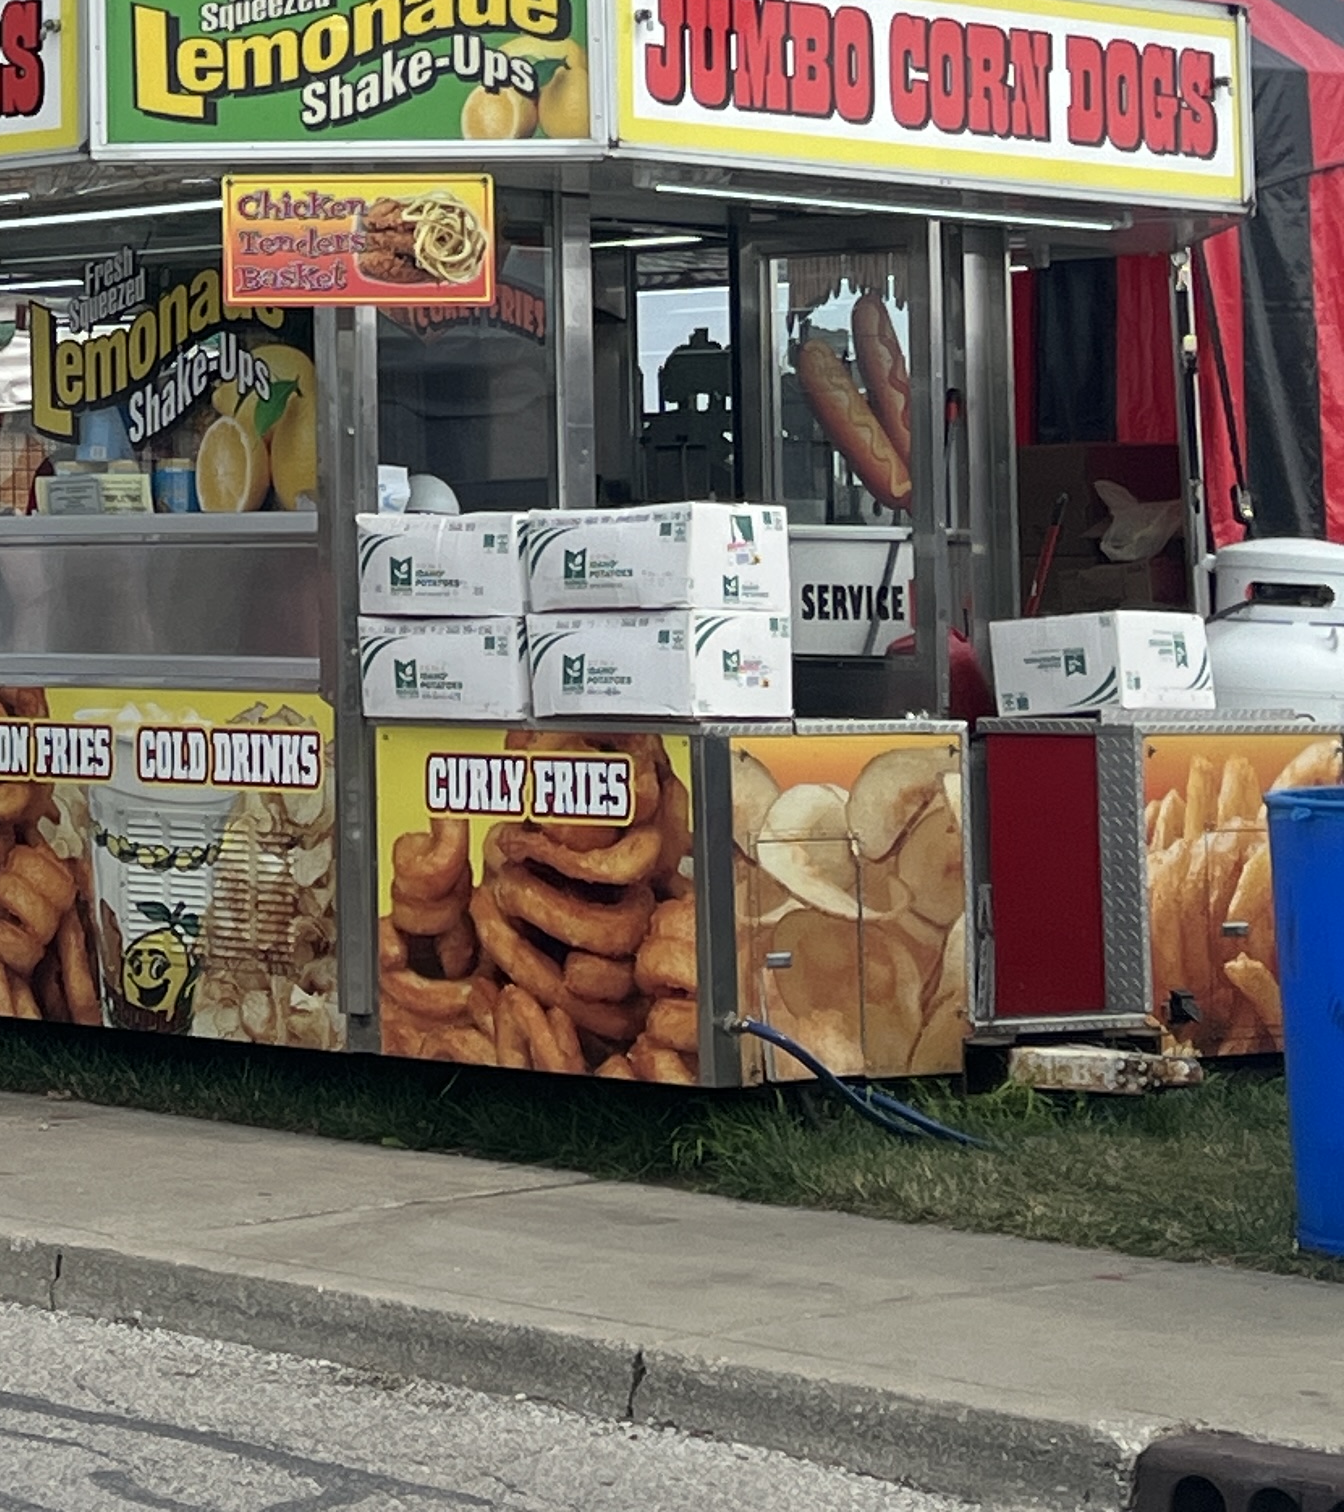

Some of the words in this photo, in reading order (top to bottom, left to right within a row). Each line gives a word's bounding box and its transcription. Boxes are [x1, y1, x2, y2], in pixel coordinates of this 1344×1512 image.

[300, 35, 534, 126] Shake-Ups
[889, 12, 1052, 142] CORN
[1065, 34, 1215, 160] DOGS
[236, 189, 369, 221] Chicken
[239, 228, 367, 258] Tenders
[84, 246, 133, 297] Fresh
[236, 259, 348, 294] Basket
[68, 268, 146, 333] Squeezed
[129, 332, 271, 443] Shake-Ups
[801, 584, 904, 621] SERVICE
[34, 728, 111, 776] FRIES
[139, 731, 207, 781] COLD
[212, 733, 319, 785] DRINKS
[428, 756, 526, 814] CURLY
[531, 759, 630, 817] FRIES
